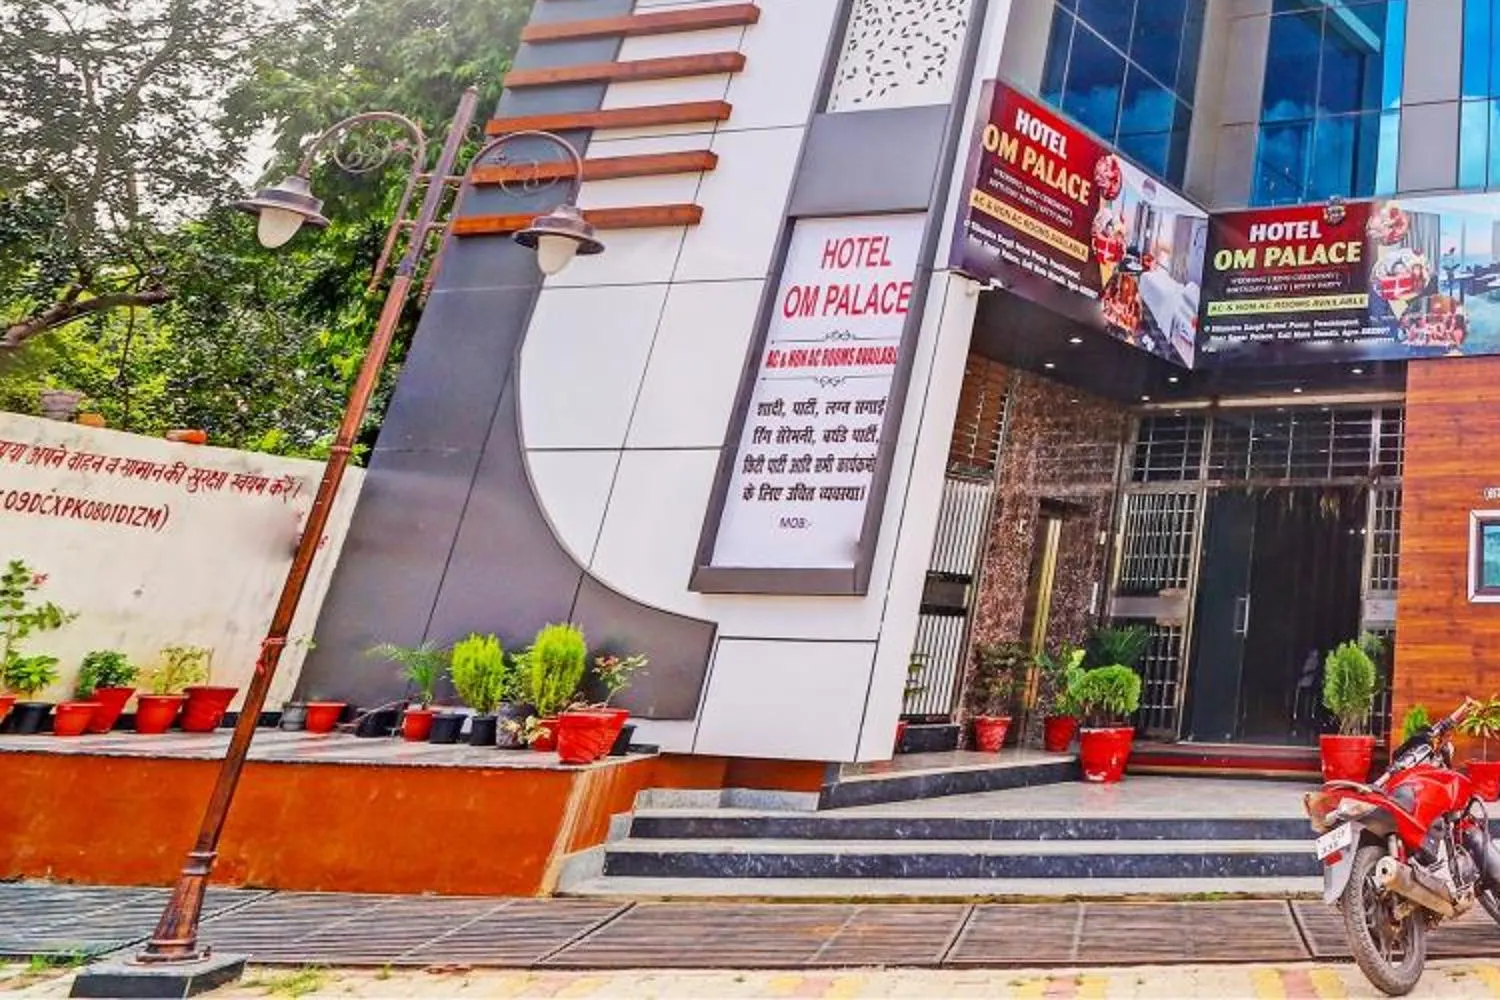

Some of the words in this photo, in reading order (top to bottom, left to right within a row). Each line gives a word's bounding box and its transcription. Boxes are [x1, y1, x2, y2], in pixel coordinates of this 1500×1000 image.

[1016, 108, 1067, 159] HOTEL
[982, 123, 1018, 165] OM
[1021, 146, 1091, 205] PALACE
[1249, 220, 1322, 243] HOTEL
[821, 236, 892, 269] HOTEL
[1213, 248, 1256, 272] OM
[1264, 241, 1362, 268] PALACE
[783, 285, 820, 318] OM
[822, 281, 913, 317] PALACE
